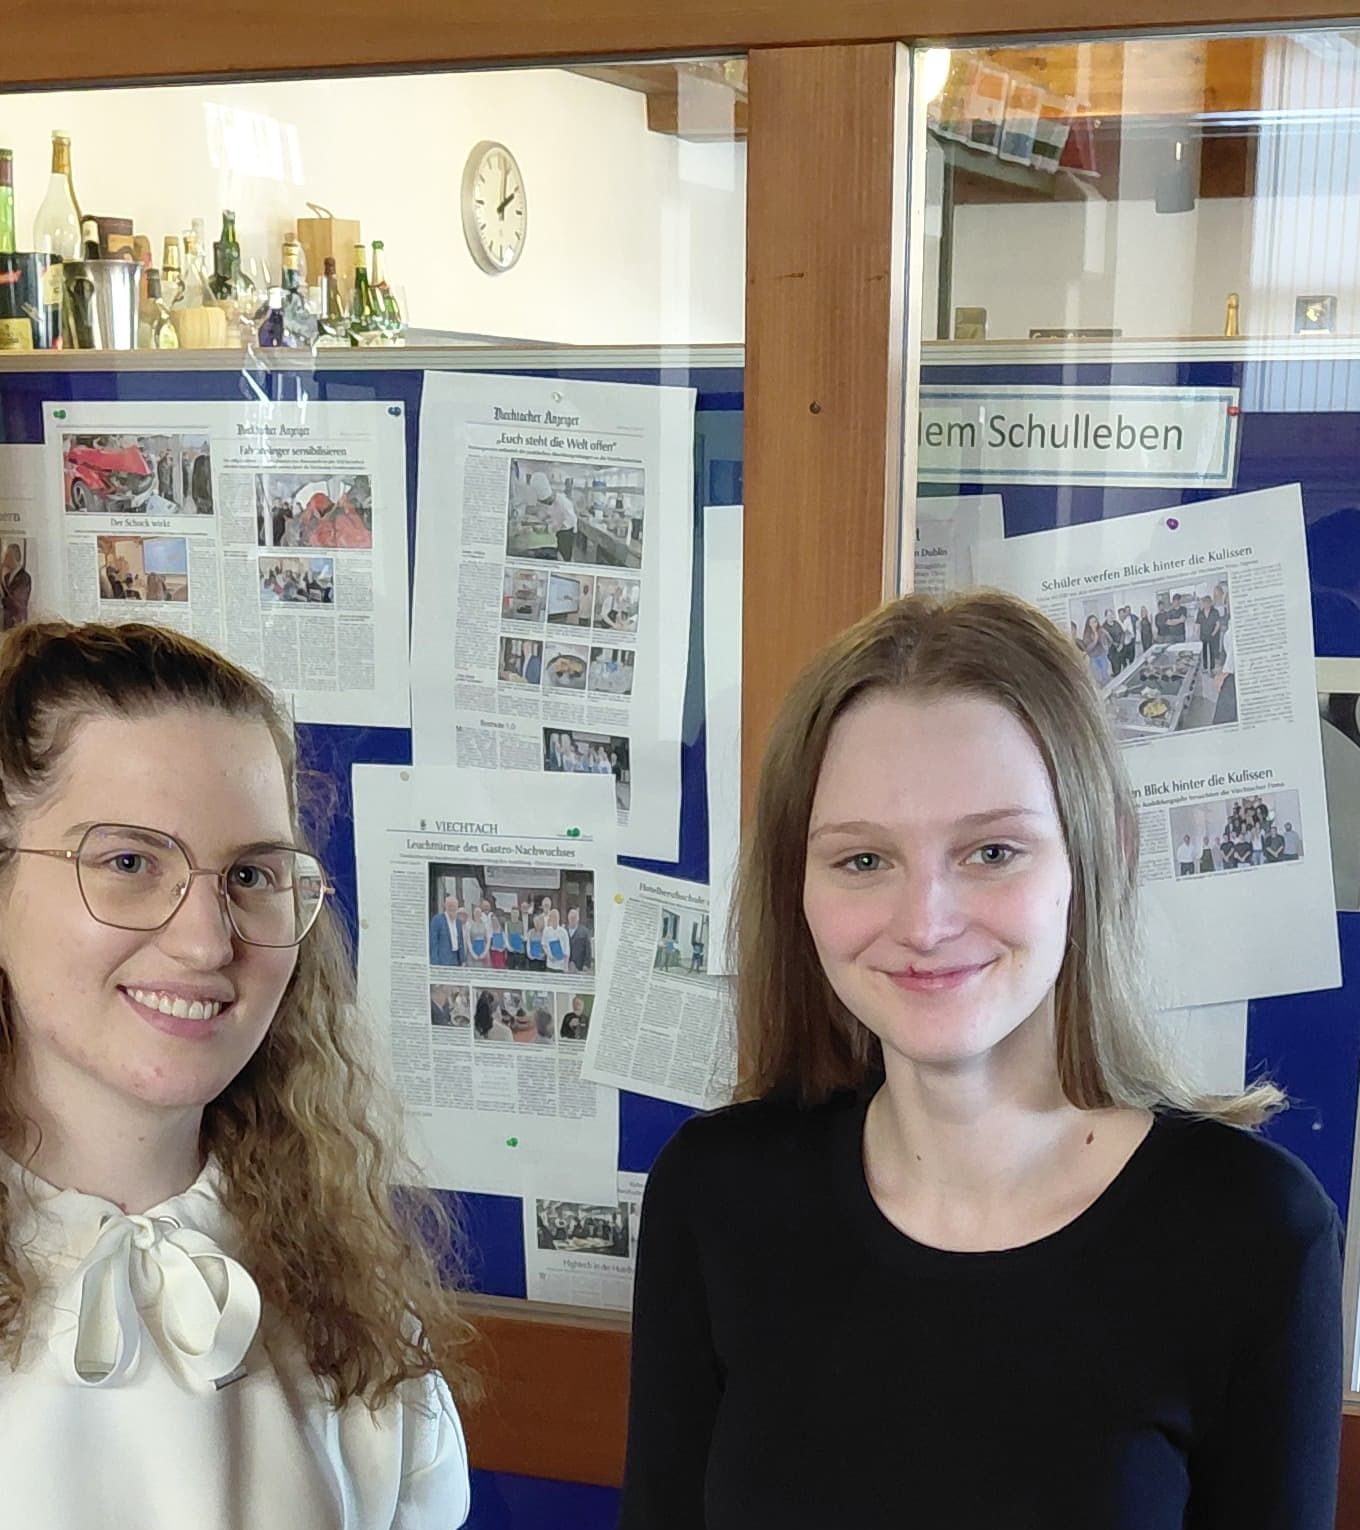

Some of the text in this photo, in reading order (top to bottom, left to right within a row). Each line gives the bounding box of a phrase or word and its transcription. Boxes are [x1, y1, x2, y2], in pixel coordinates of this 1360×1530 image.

[918, 411, 1183, 451] em Schulleben
[525, 436, 548, 448] steht
[550, 436, 565, 449] die
[566, 438, 588, 451] Welt
[1041, 575, 1082, 592] Schüler
[1084, 568, 1120, 585] werfen
[1123, 562, 1150, 578] Blick
[1153, 558, 1185, 573] hinter
[1188, 554, 1205, 566] die
[1208, 546, 1253, 563] Kulissen
[1144, 781, 1170, 798] Blick
[1172, 777, 1206, 792] hinter
[1207, 774, 1225, 787] die
[1227, 768, 1274, 784] Kulissen
[435, 820, 498, 835] VIECHTACH
[463, 841, 479, 853] des
[481, 843, 576, 858] Gastro-Nachwuchses
